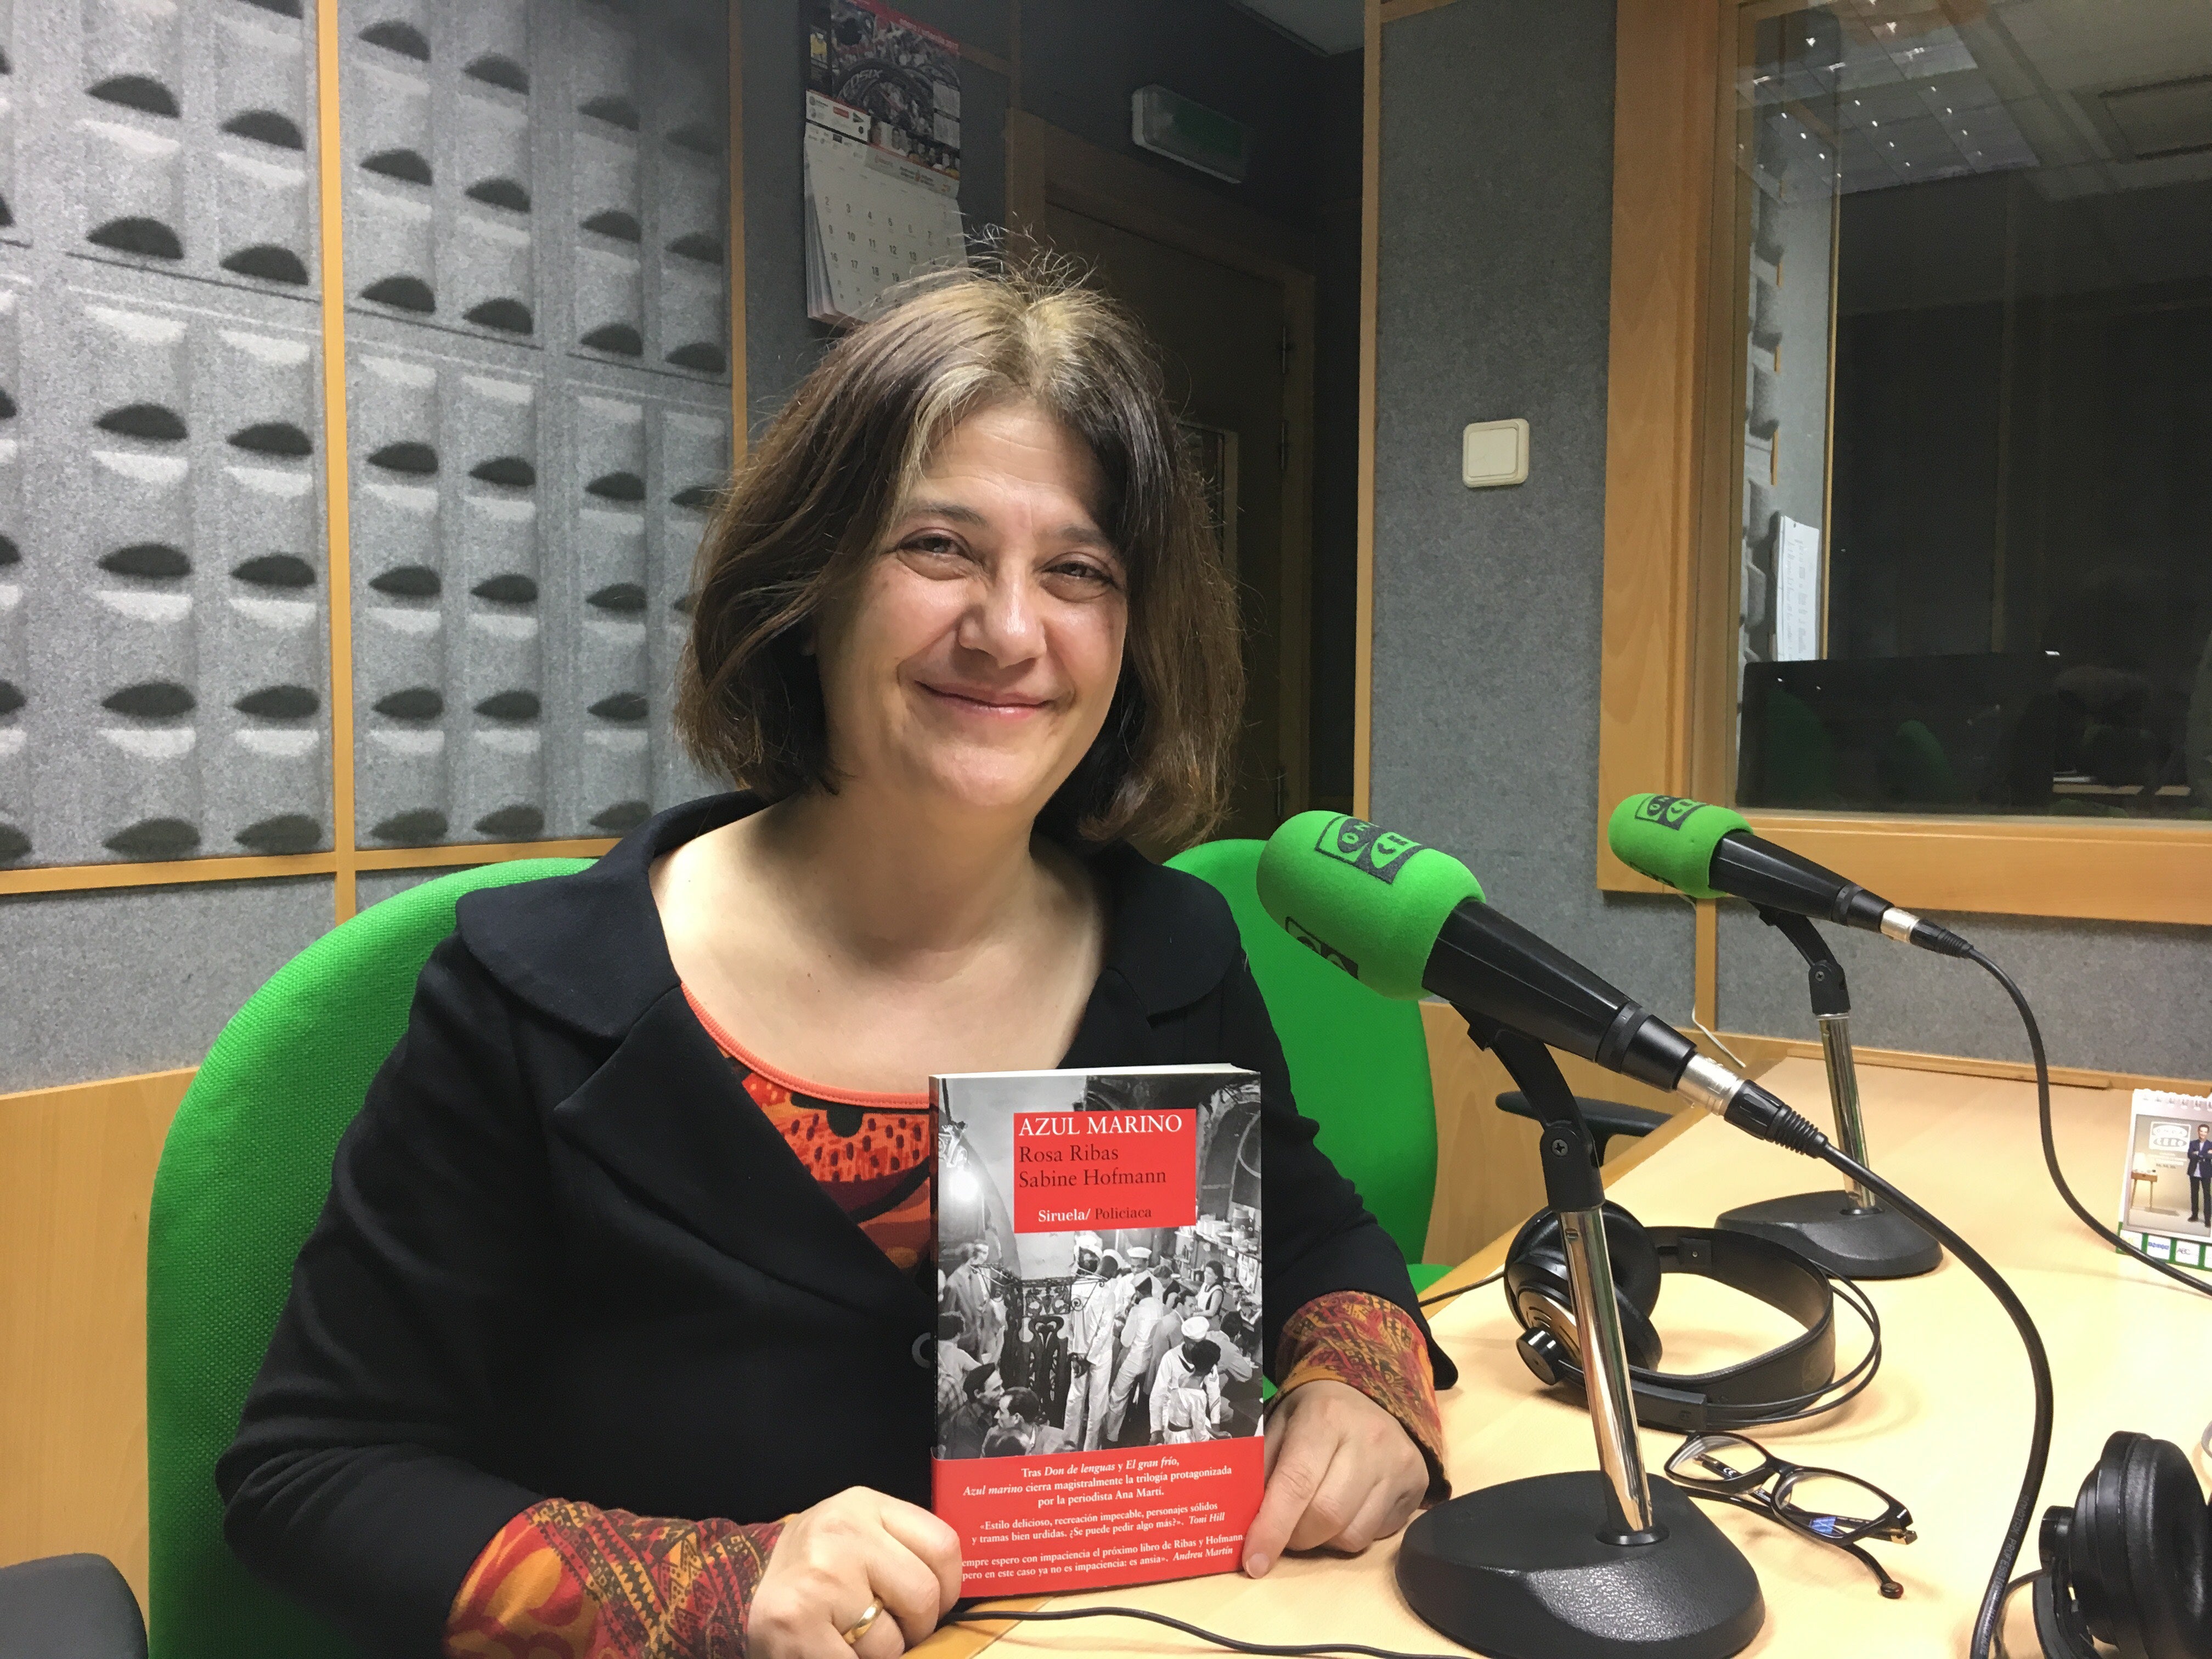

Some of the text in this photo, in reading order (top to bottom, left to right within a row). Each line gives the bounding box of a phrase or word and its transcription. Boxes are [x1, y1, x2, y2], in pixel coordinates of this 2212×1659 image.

[825, 196, 830, 206] 2
[846, 204, 851, 213] 3
[867, 211, 872, 219] 4
[888, 218, 893, 227] 5
[847, 231, 856, 242] 10
[869, 238, 876, 248] 11
[889, 245, 898, 255] 12
[909, 251, 917, 261] 13
[851, 259, 859, 269] 17
[872, 266, 880, 276] 18
[892, 273, 900, 282] 19
[1018, 1114, 1182, 1136] AZUL MARINO
[1019, 1143, 1119, 1163] Rosa Ribas
[1019, 1167, 1166, 1188] Sabine Hofmann
[1038, 1207, 1152, 1222] Siruela/ Policiaca
[1021, 1455, 1180, 1478] Tras Don de lenguas y El gran frío,
[1723, 1467, 1737, 1476] CE
[963, 1466, 1232, 1497] Azul marino cierra magistralmente la trilogía protagonizada
[1038, 1486, 1165, 1508] por la periodista Ana Martí.
[980, 1501, 1218, 1531] «Estilo delicioso, recreación impecable, personajes sólidos
[972, 1512, 1226, 1545] y tramas bien urdidas. ¿Se puede pedir algo más?». Toni Hill
[962, 1559, 989, 1568] empre
[991, 1554, 1019, 1567] espero
[1022, 1554, 1038, 1564] con
[1040, 1549, 1091, 1565] impaciencia
[1092, 1547, 1101, 1558] el
[1103, 1543, 1138, 1558] próximo
[1140, 1541, 1160, 1553] libro
[1162, 1540, 1172, 1550] de
[1174, 1537, 1197, 1549] Ribas
[1199, 1538, 1204, 1548] y
[962, 1545, 1233, 1582] pero en este caso ya no es impaciencia: es ansia». Andreu Martín
